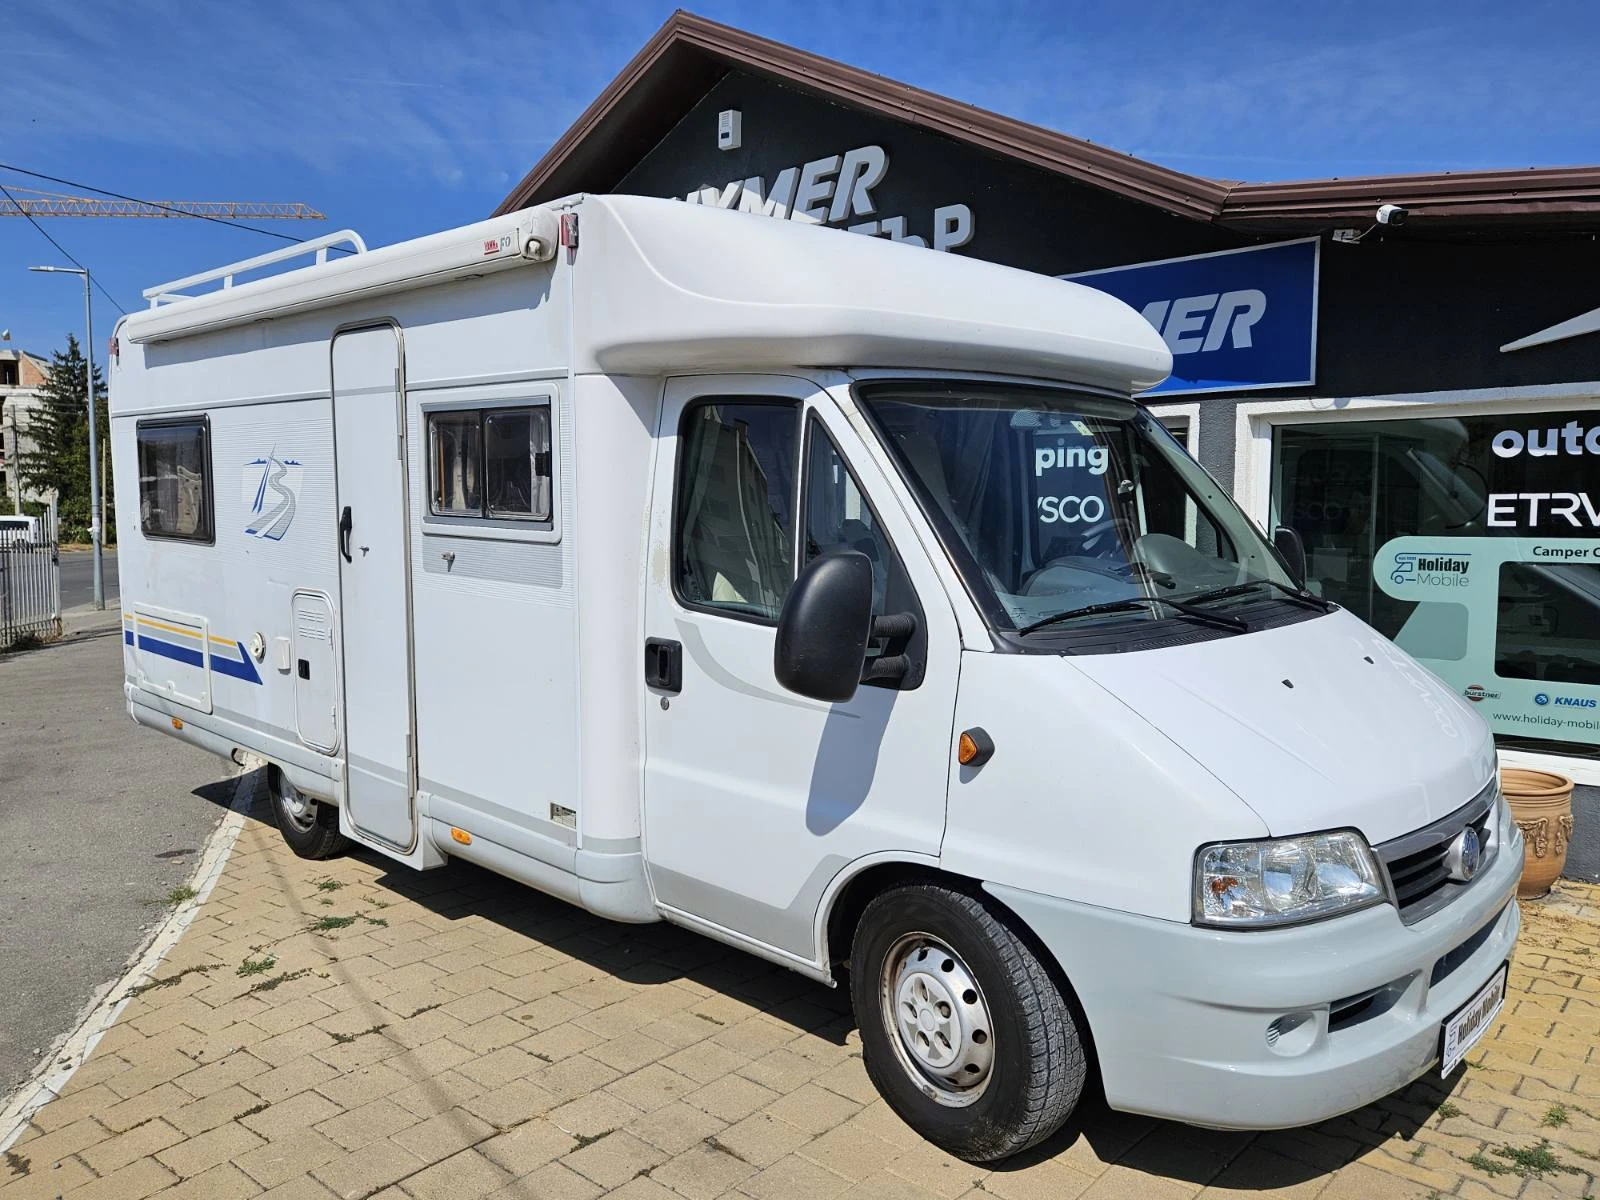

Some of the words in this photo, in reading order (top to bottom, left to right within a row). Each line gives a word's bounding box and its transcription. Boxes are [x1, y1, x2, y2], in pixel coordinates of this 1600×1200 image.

[673, 145, 889, 226] MER
[1035, 438, 1109, 477] ping
[1037, 495, 1105, 523] SCO
[1532, 545, 1590, 560] Camper
[1418, 557, 1470, 575] Holiday
[1417, 573, 1470, 587] Mobile
[1554, 696, 1597, 708] KNAUS
[1493, 712, 1600, 731] www.holiday-mobil
